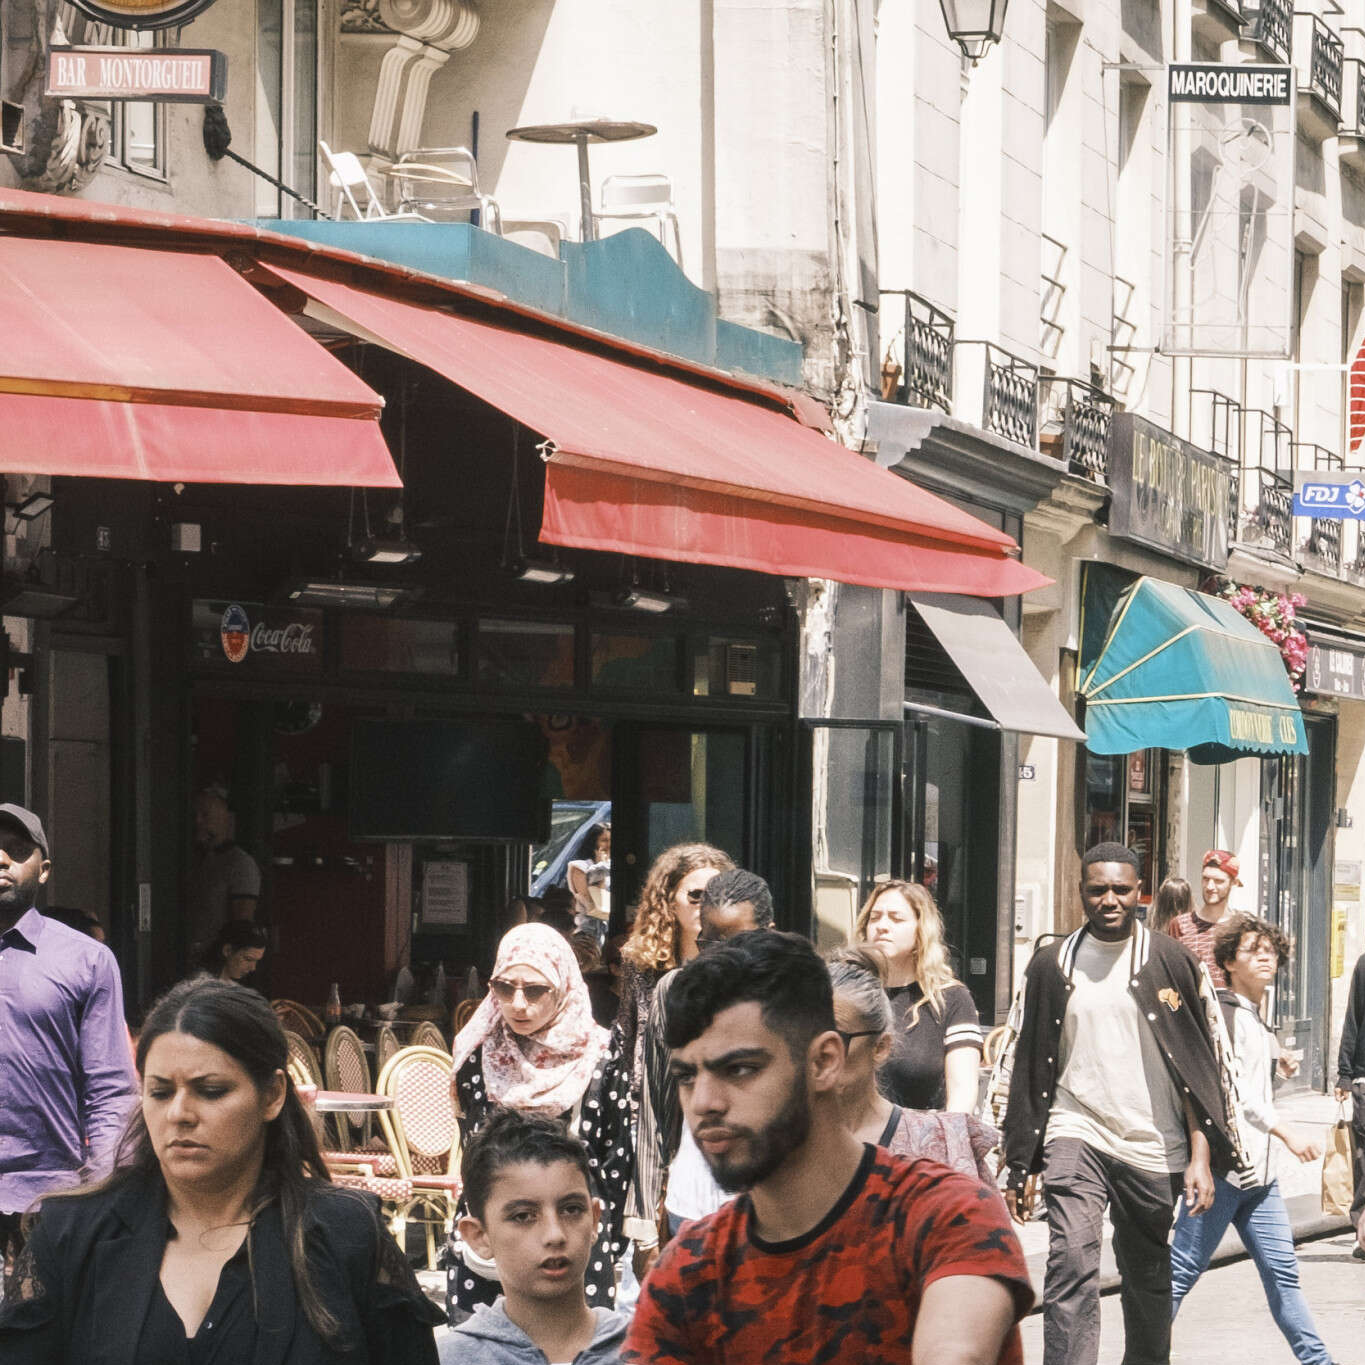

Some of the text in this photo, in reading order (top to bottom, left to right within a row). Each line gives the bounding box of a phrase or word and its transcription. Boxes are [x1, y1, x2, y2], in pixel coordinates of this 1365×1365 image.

[57, 57, 204, 90] BAR MONTORGUEIL
[1171, 71, 1287, 97] MAROQUINERIE
[1304, 485, 1340, 503] FDJ
[251, 622, 314, 653] Coca-Cola
